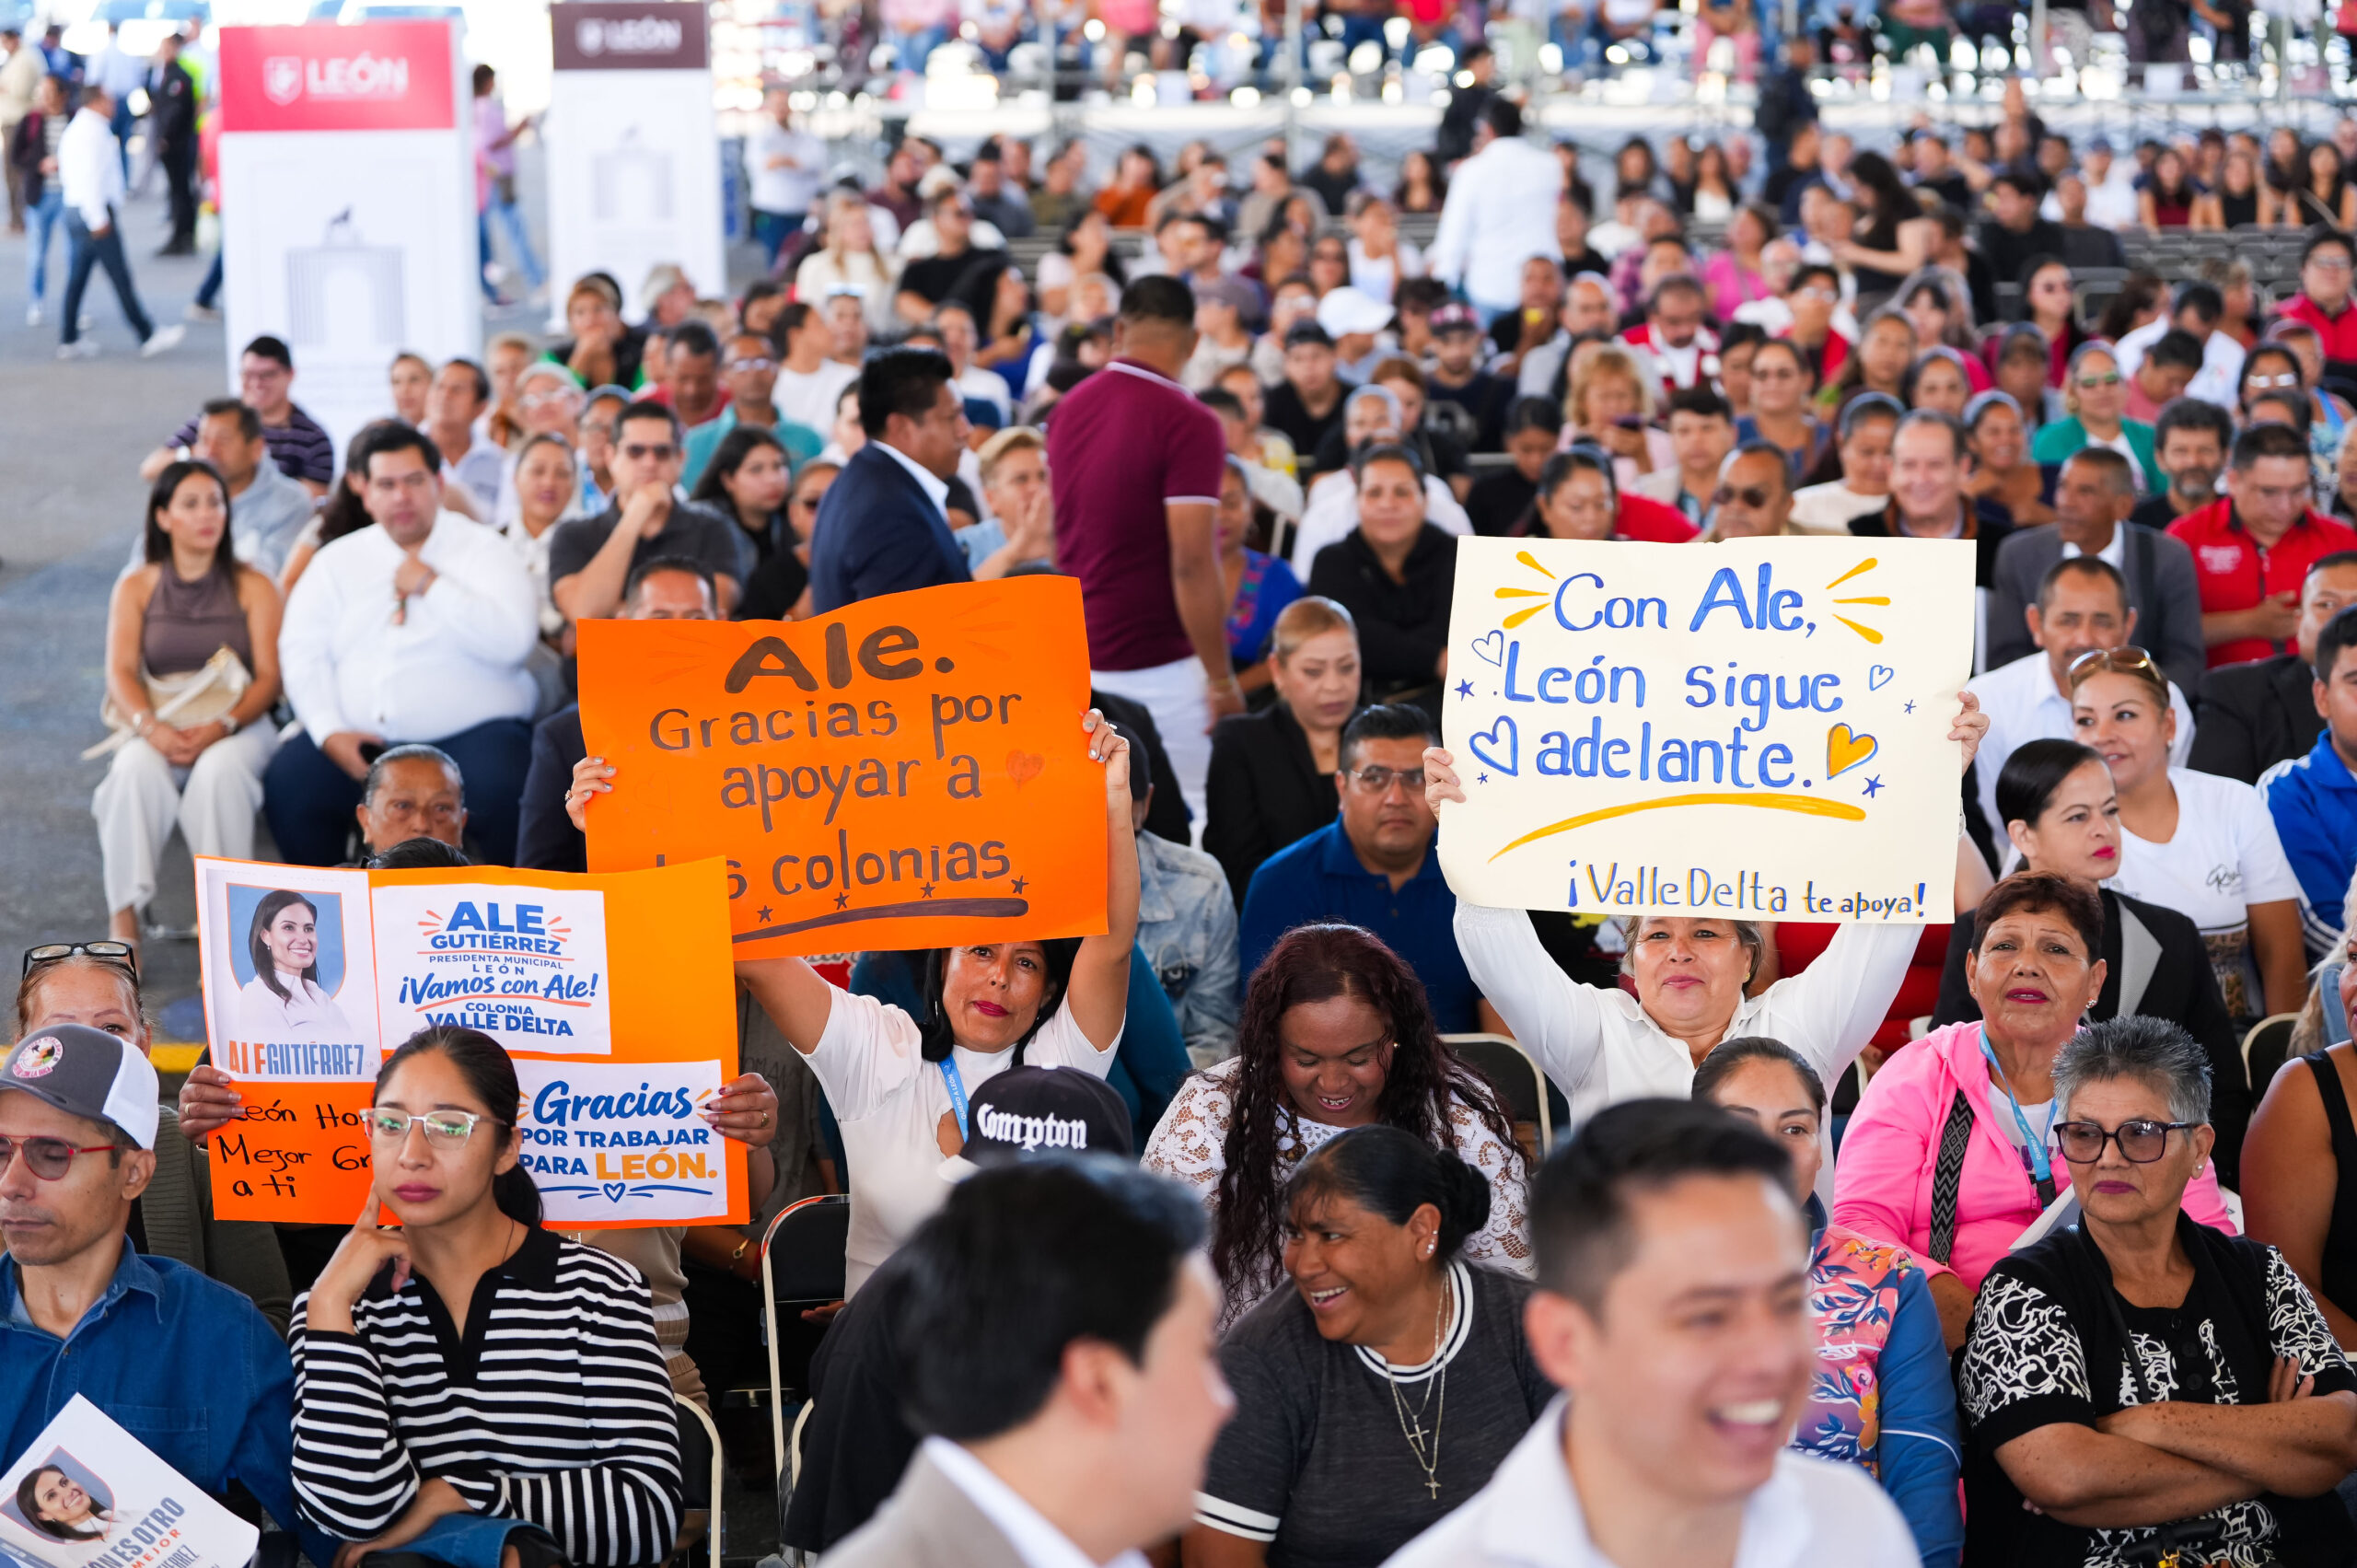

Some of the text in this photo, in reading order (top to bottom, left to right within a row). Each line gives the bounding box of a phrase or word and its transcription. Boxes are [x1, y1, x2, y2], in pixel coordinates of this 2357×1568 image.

[306, 51, 409, 95] LEÓN
[1554, 562, 1817, 638] Con Ale,
[724, 621, 955, 694] Ale.
[1504, 641, 1843, 732] León sigue
[649, 693, 1022, 761] Gracias por
[1536, 716, 1812, 789] adelante.
[720, 754, 983, 833] apoyar a
[772, 829, 1011, 897] colonias
[446, 901, 546, 936] ALE
[1801, 880, 1834, 913] te
[1838, 882, 1926, 921] apoya!
[429, 954, 564, 970] PRESIDENTA MUNICIPAL
[431, 933, 562, 957] GUTIÉRREZ
[399, 972, 598, 1005] ¡Vamos con Ale!
[465, 1003, 535, 1016] COLONIA
[505, 1015, 575, 1037] DELTA
[316, 1103, 360, 1130] Ho
[532, 1080, 693, 1128] Gracias
[519, 1128, 711, 1148] POR TRABAJAR
[977, 1103, 1087, 1152] Compton
[518, 1147, 718, 1180] PARA LEÓN.
[232, 1174, 296, 1198] a ti
[110, 1537, 144, 1563] ES
[131, 1496, 186, 1546] OTRO
[132, 1527, 181, 1568] MEJOR
